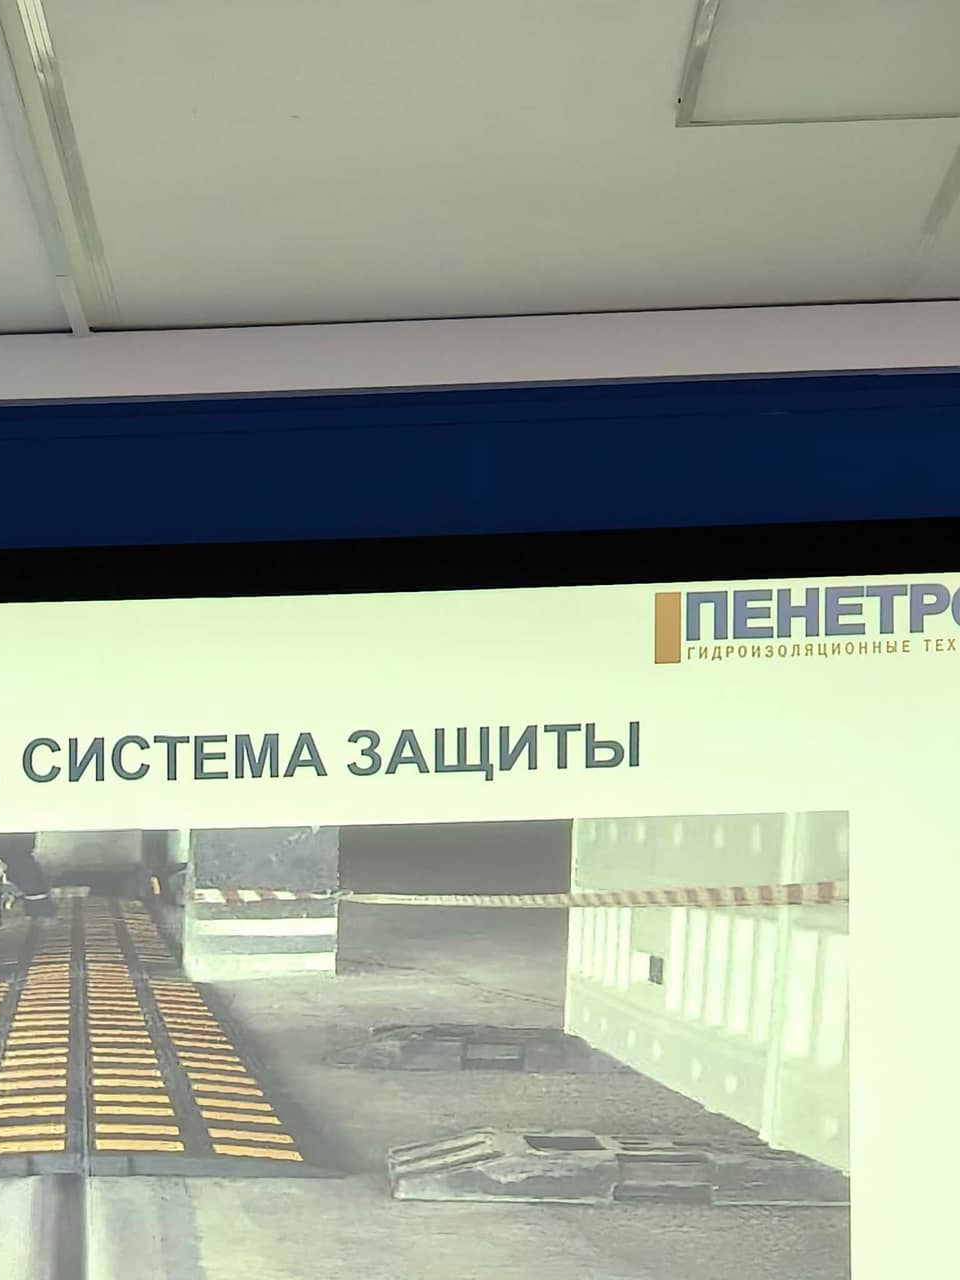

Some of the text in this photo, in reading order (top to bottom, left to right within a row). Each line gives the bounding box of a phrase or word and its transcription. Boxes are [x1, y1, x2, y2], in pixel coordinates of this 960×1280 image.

[686, 583, 960, 641] ПЕНЕТР
[687, 639, 911, 661] ГИДРОИЗОЛЯЦИОННЫЕ
[22, 732, 328, 783] СИСТЕМА
[346, 721, 640, 781] ЗАЩИТЫ
